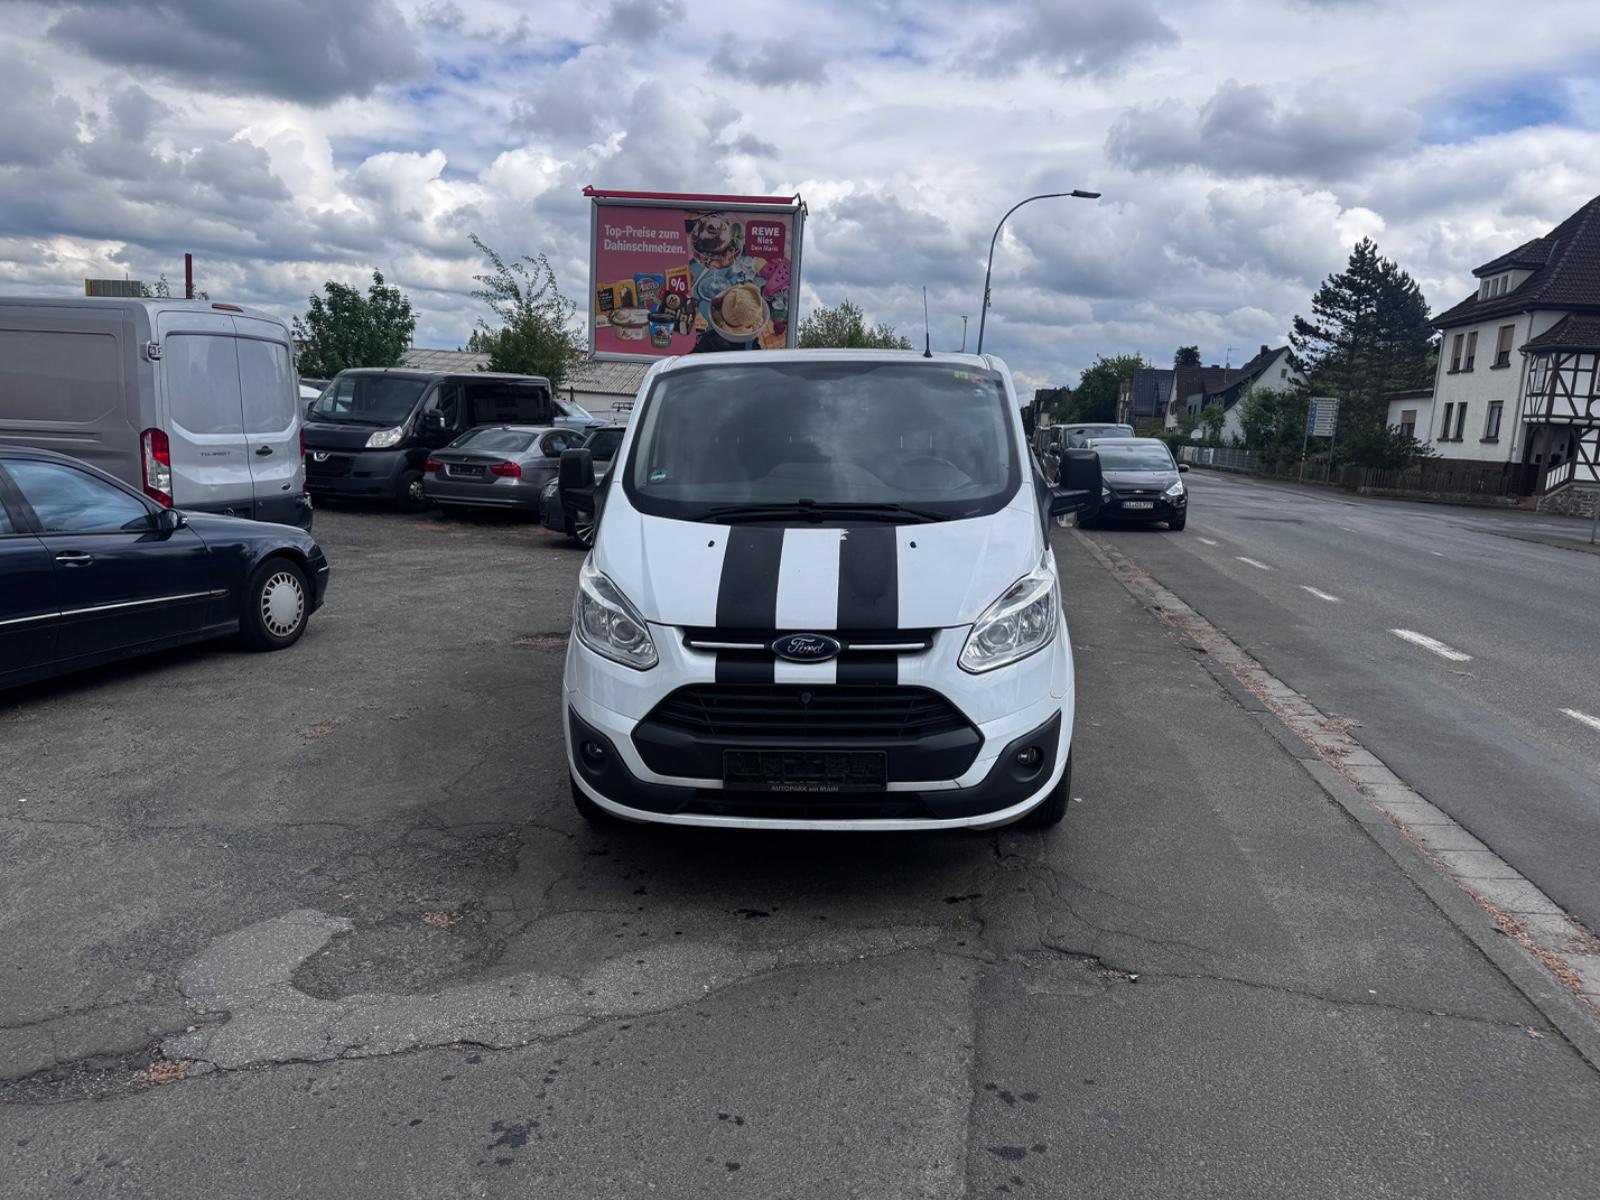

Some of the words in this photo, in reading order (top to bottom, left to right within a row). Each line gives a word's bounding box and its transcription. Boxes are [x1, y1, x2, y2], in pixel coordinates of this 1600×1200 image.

[604, 224, 656, 239] Top-Preise
[658, 230, 680, 240] zum
[751, 226, 780, 237] REWE
[604, 240, 686, 255] Dahinschmelzen.
[671, 277, 686, 291] %
[787, 637, 825, 654] Ford
